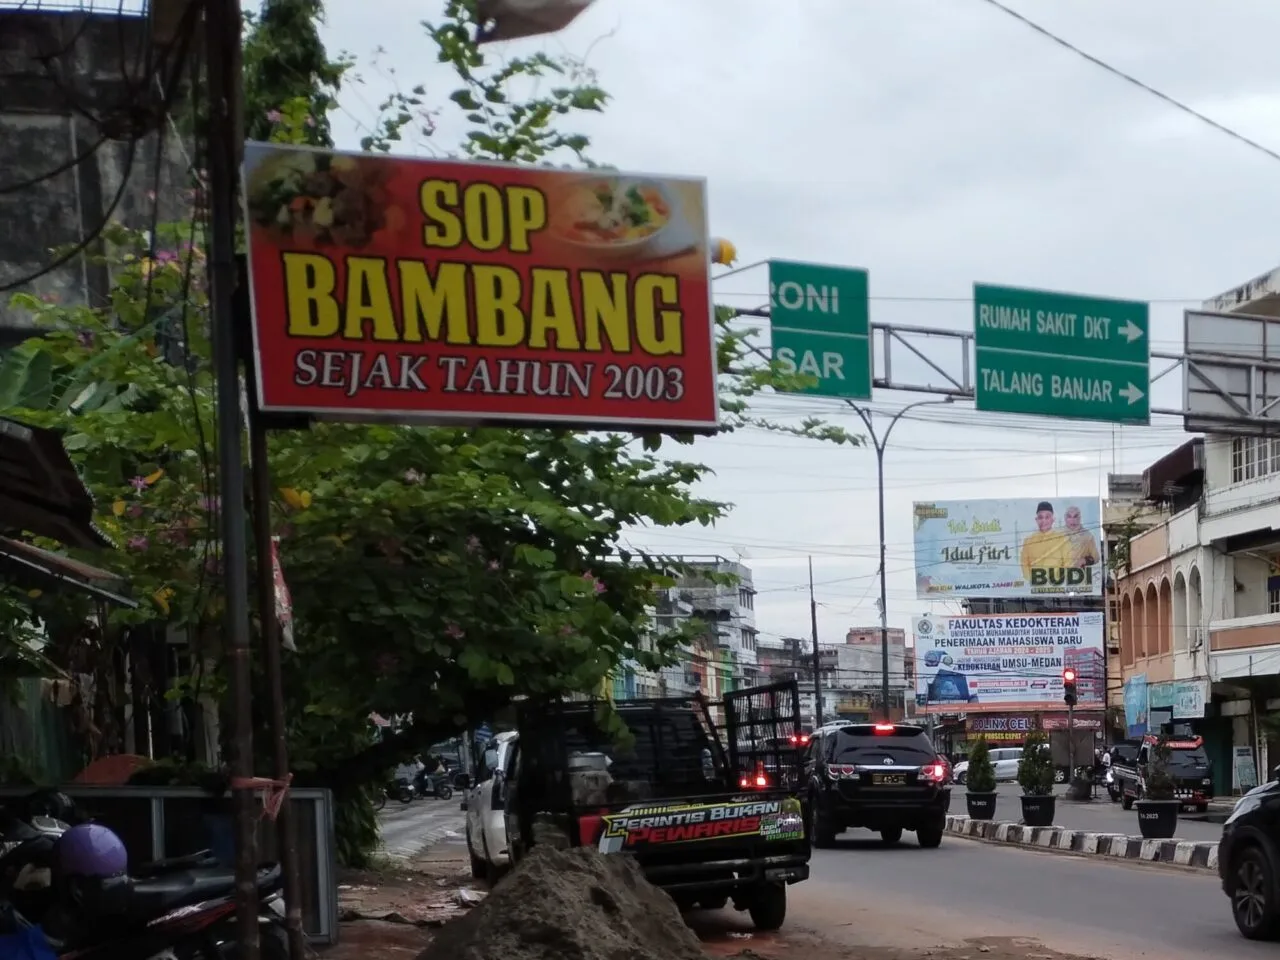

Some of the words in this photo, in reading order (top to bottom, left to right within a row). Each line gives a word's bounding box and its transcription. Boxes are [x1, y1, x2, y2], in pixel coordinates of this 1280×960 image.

[419, 178, 547, 253] SOP
[281, 250, 684, 356] BAMBANG
[979, 304, 1031, 332] RUMAH
[1036, 309, 1077, 338] SAKIT
[1083, 315, 1111, 341] DKT
[294, 350, 430, 397] SEJAK
[438, 356, 595, 400] TAHUN
[604, 364, 685, 402] 2003
[981, 368, 1044, 398] TALANG
[1051, 374, 1113, 403] BANJAR
[941, 545, 976, 563] Idul
[954, 583, 991, 591] WALIKOTA
[1031, 567, 1093, 586] BUDI
[948, 618, 1003, 630] FAKULTAS
[1005, 617, 1080, 629] KEDOKTERAN
[950, 630, 985, 638] UNIVERSITAS
[985, 629, 1031, 637] MUHAMMADIYAH
[1031, 628, 1060, 636] SUMATERA
[1060, 627, 1079, 635] UTARA
[934, 638, 996, 648] PENERIMAAN
[997, 636, 1055, 647] MAHASISWA
[1057, 635, 1083, 645] BARU
[1002, 657, 1062, 668] UMSU-MEDAN
[611, 811, 706, 832] PERINTIS
[710, 801, 780, 821] BUKAN
[626, 815, 761, 845] PEWARIS
